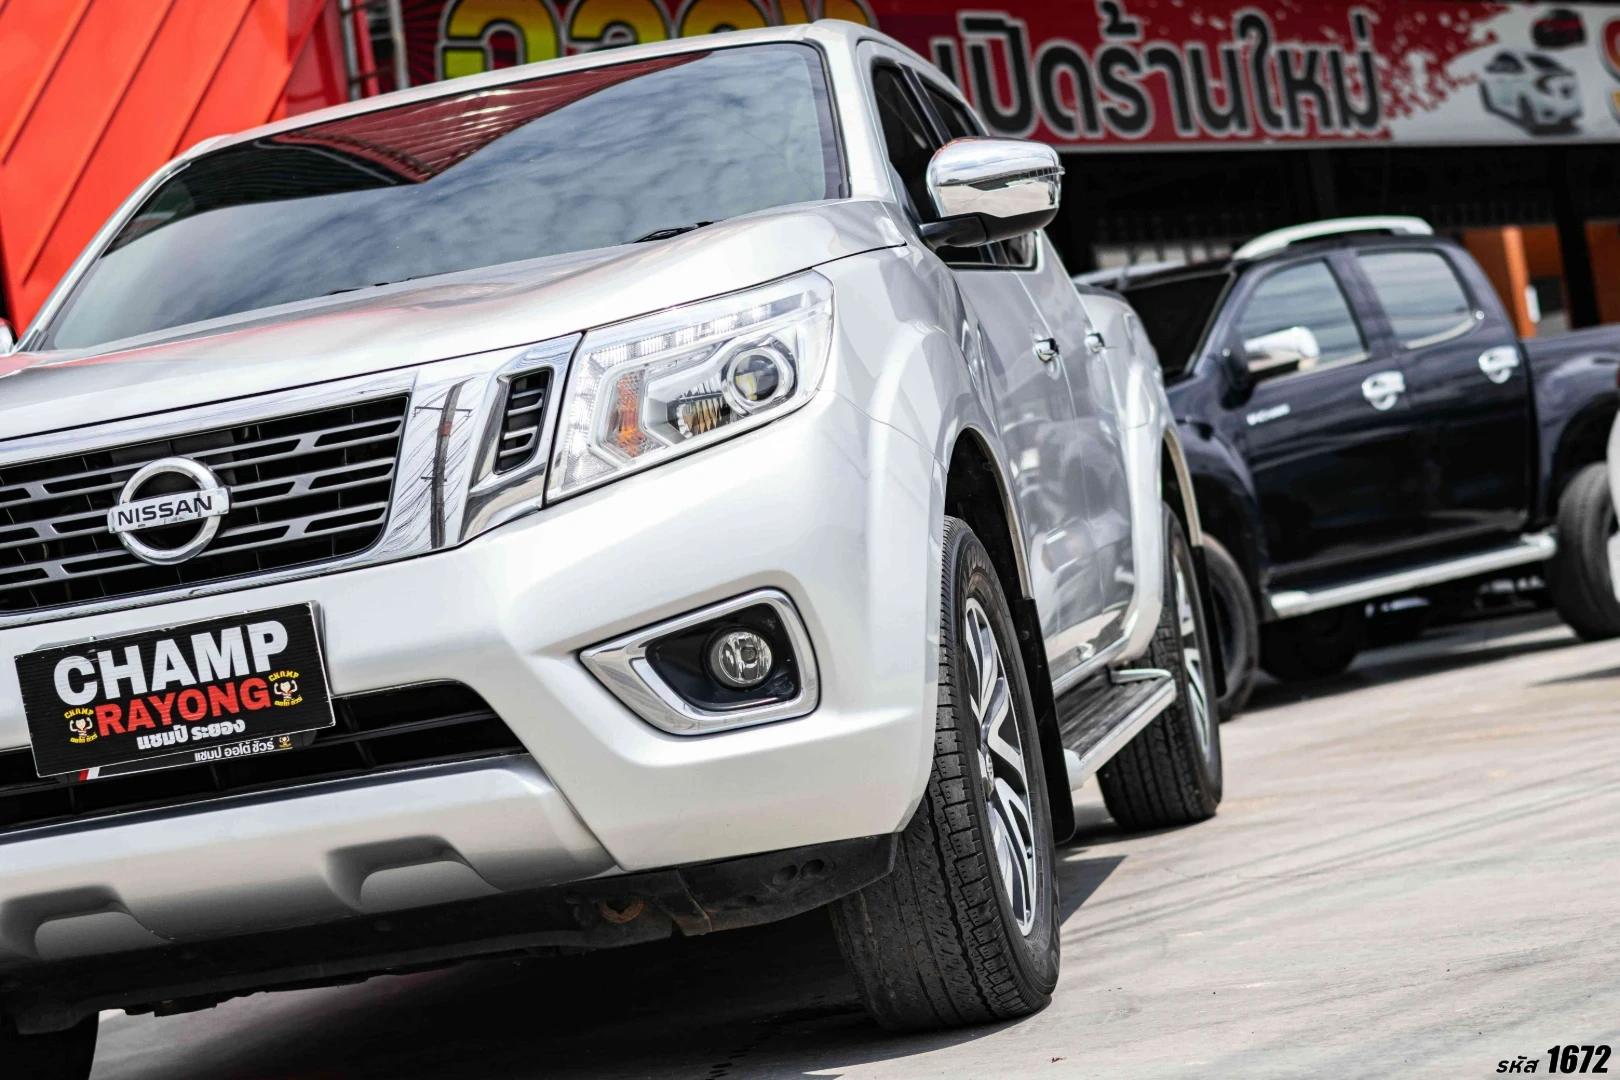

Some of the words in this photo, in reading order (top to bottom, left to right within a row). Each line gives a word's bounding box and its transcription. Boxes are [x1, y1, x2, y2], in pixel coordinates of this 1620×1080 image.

[117, 495, 213, 527] NISSAN
[53, 619, 288, 706] CHAMP
[268, 670, 300, 682] CHAMP
[63, 707, 95, 719] CHAMP
[94, 677, 272, 738] RAYONG
[190, 719, 246, 742] ระยอง
